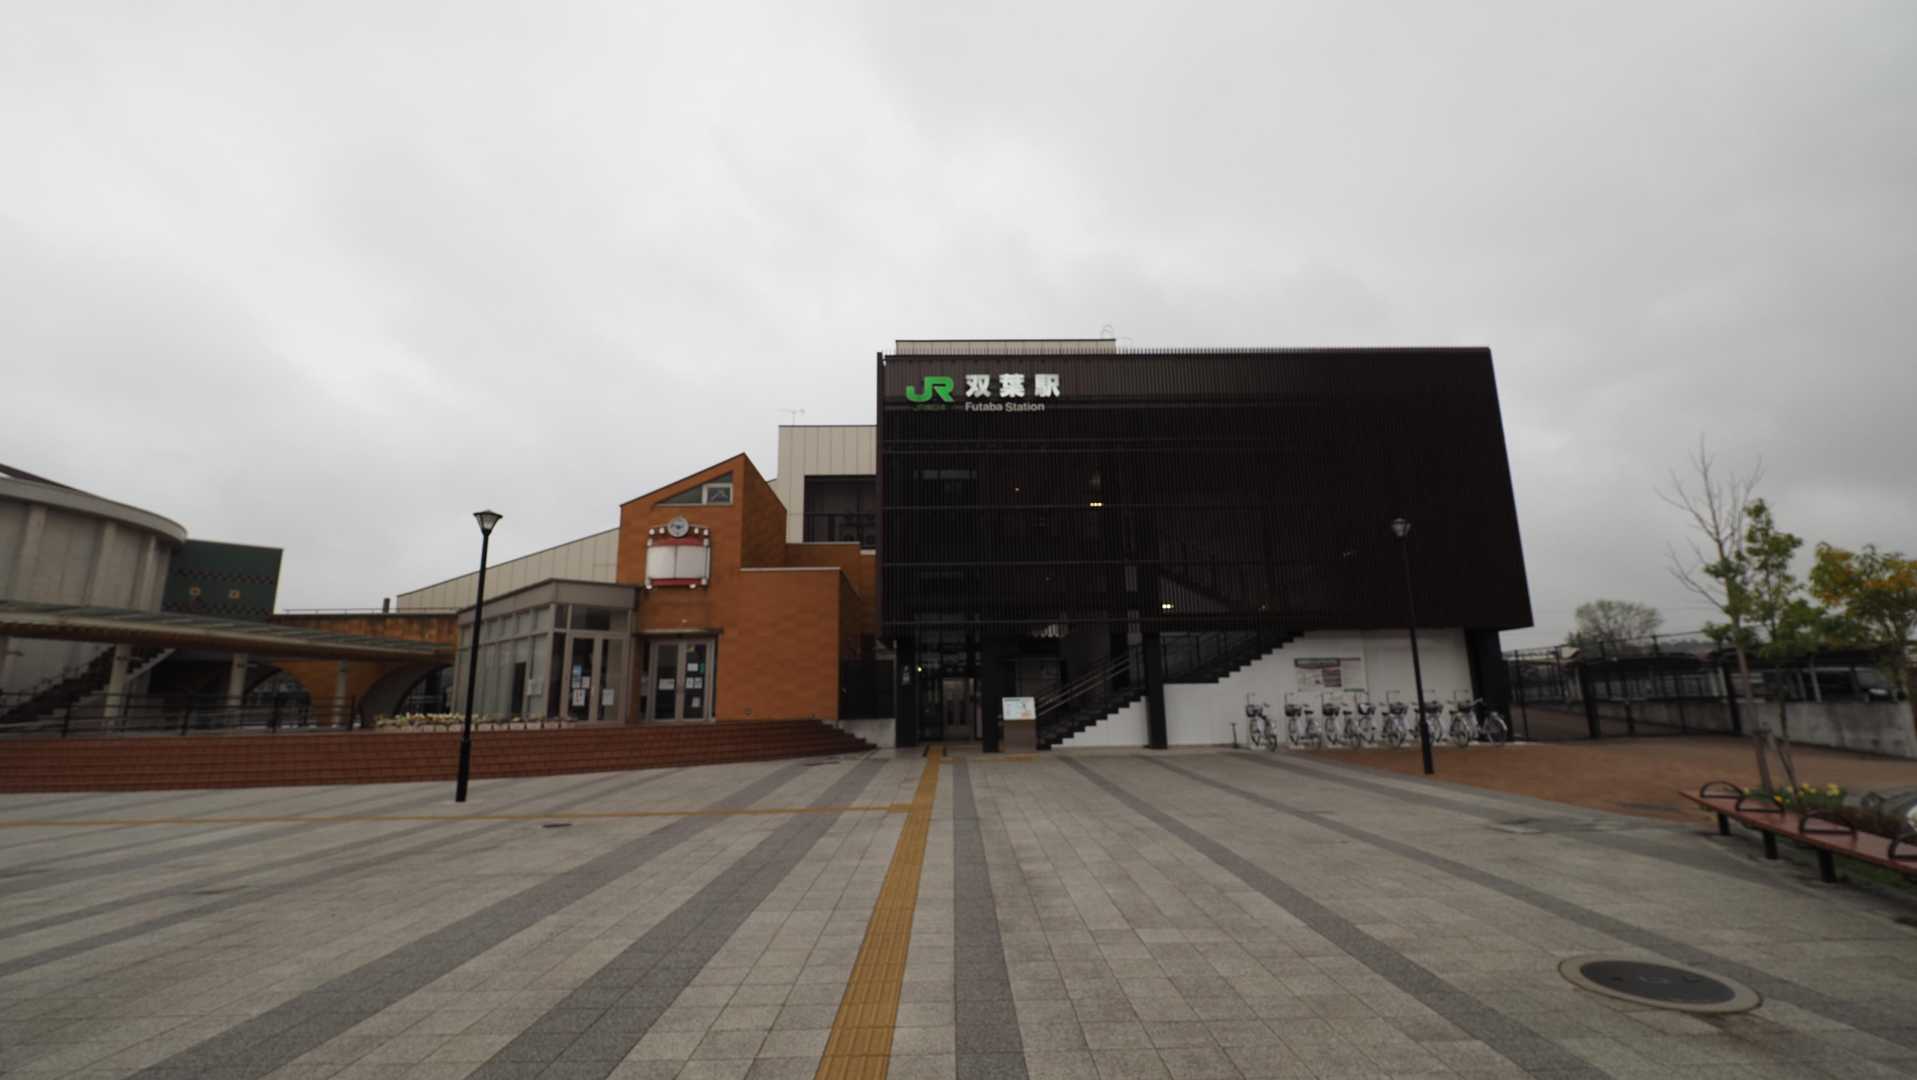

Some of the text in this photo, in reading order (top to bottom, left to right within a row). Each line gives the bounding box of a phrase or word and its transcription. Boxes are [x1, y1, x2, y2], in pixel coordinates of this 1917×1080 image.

[906, 376, 954, 402] JR
[965, 373, 1060, 397] 双葉駅
[965, 402, 1045, 412] Futaba Station
